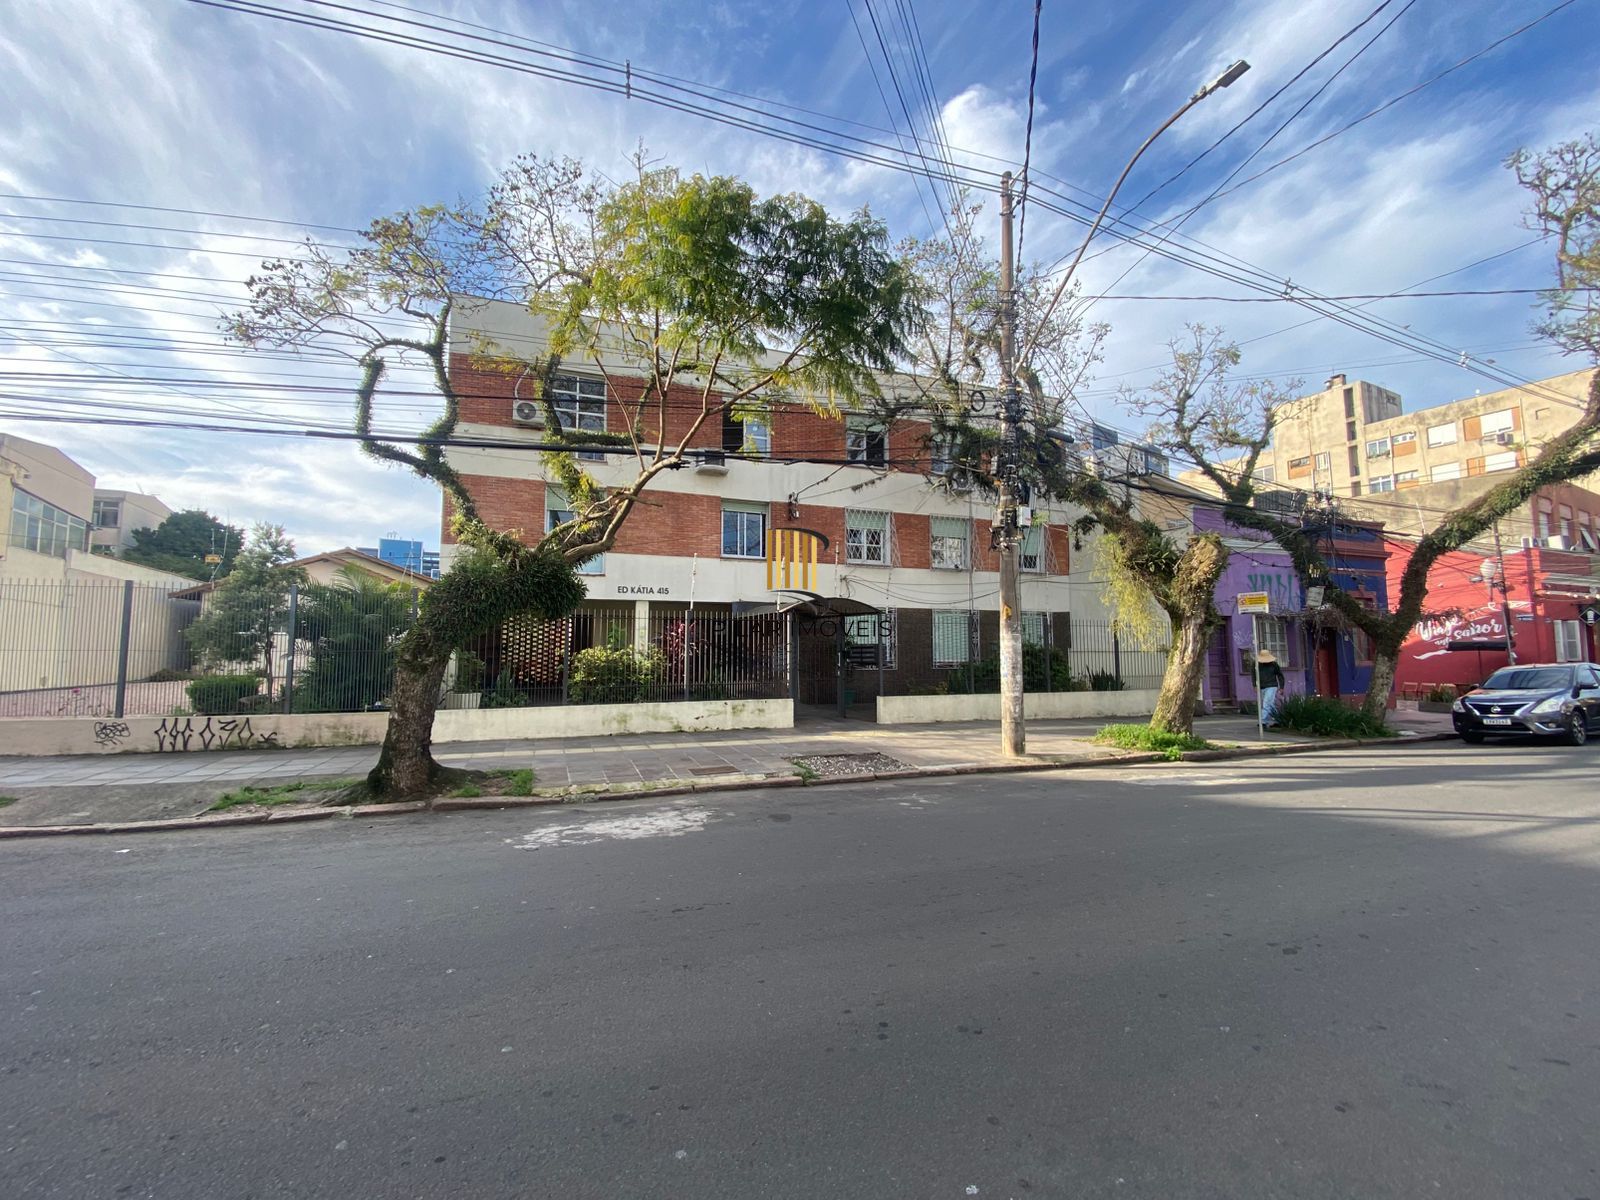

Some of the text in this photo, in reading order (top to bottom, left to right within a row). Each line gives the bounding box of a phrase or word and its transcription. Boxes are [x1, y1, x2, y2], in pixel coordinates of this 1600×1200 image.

[617, 584, 670, 595] ED KÁTIA 415
